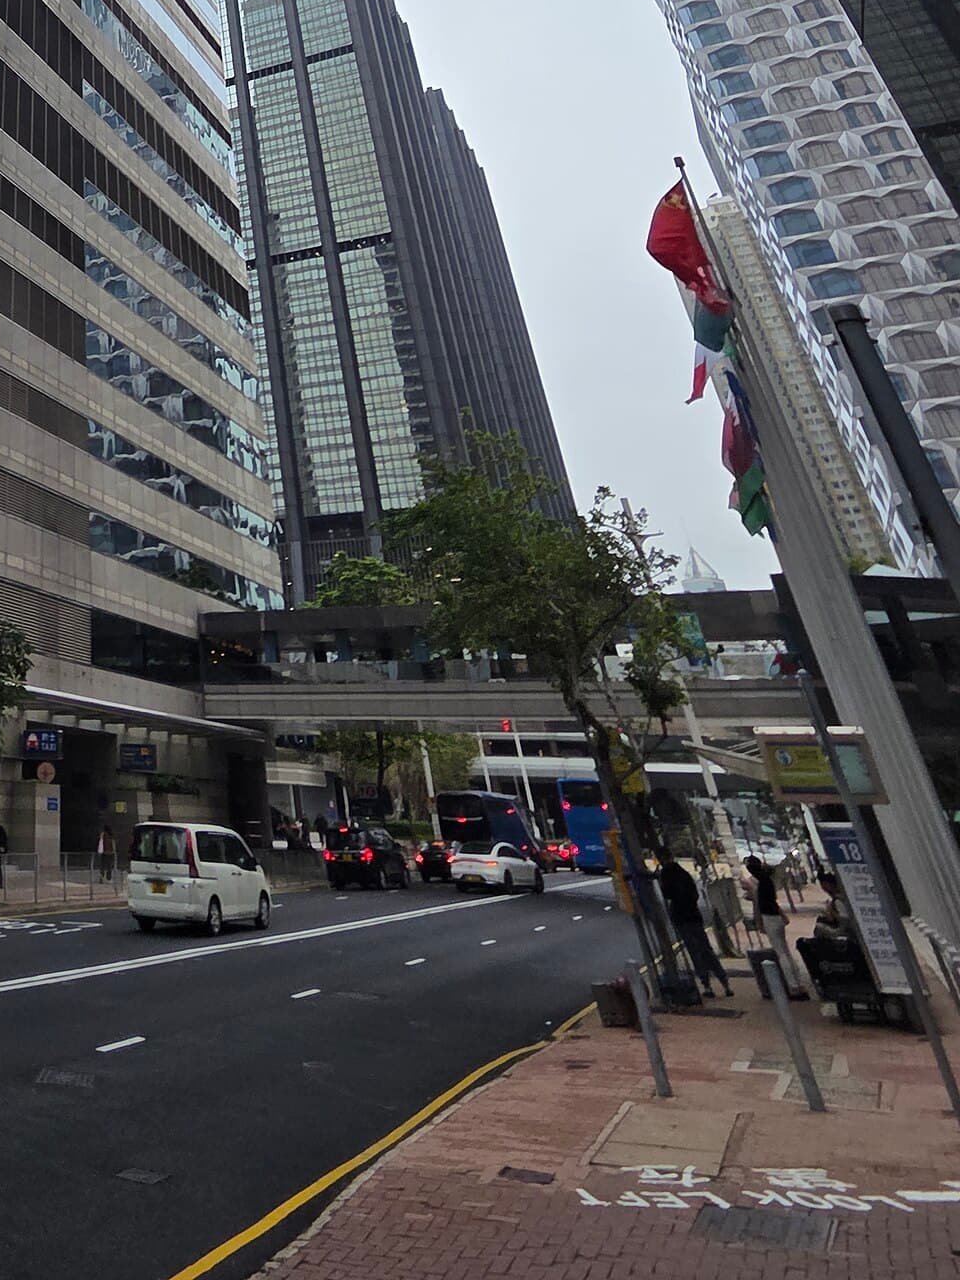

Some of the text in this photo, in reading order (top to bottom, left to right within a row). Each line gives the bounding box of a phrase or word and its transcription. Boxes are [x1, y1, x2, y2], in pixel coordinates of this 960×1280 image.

[41, 742, 56, 751] TAXI
[839, 842, 863, 862] 18
[575, 1187, 915, 1213] LOOK LEFT
